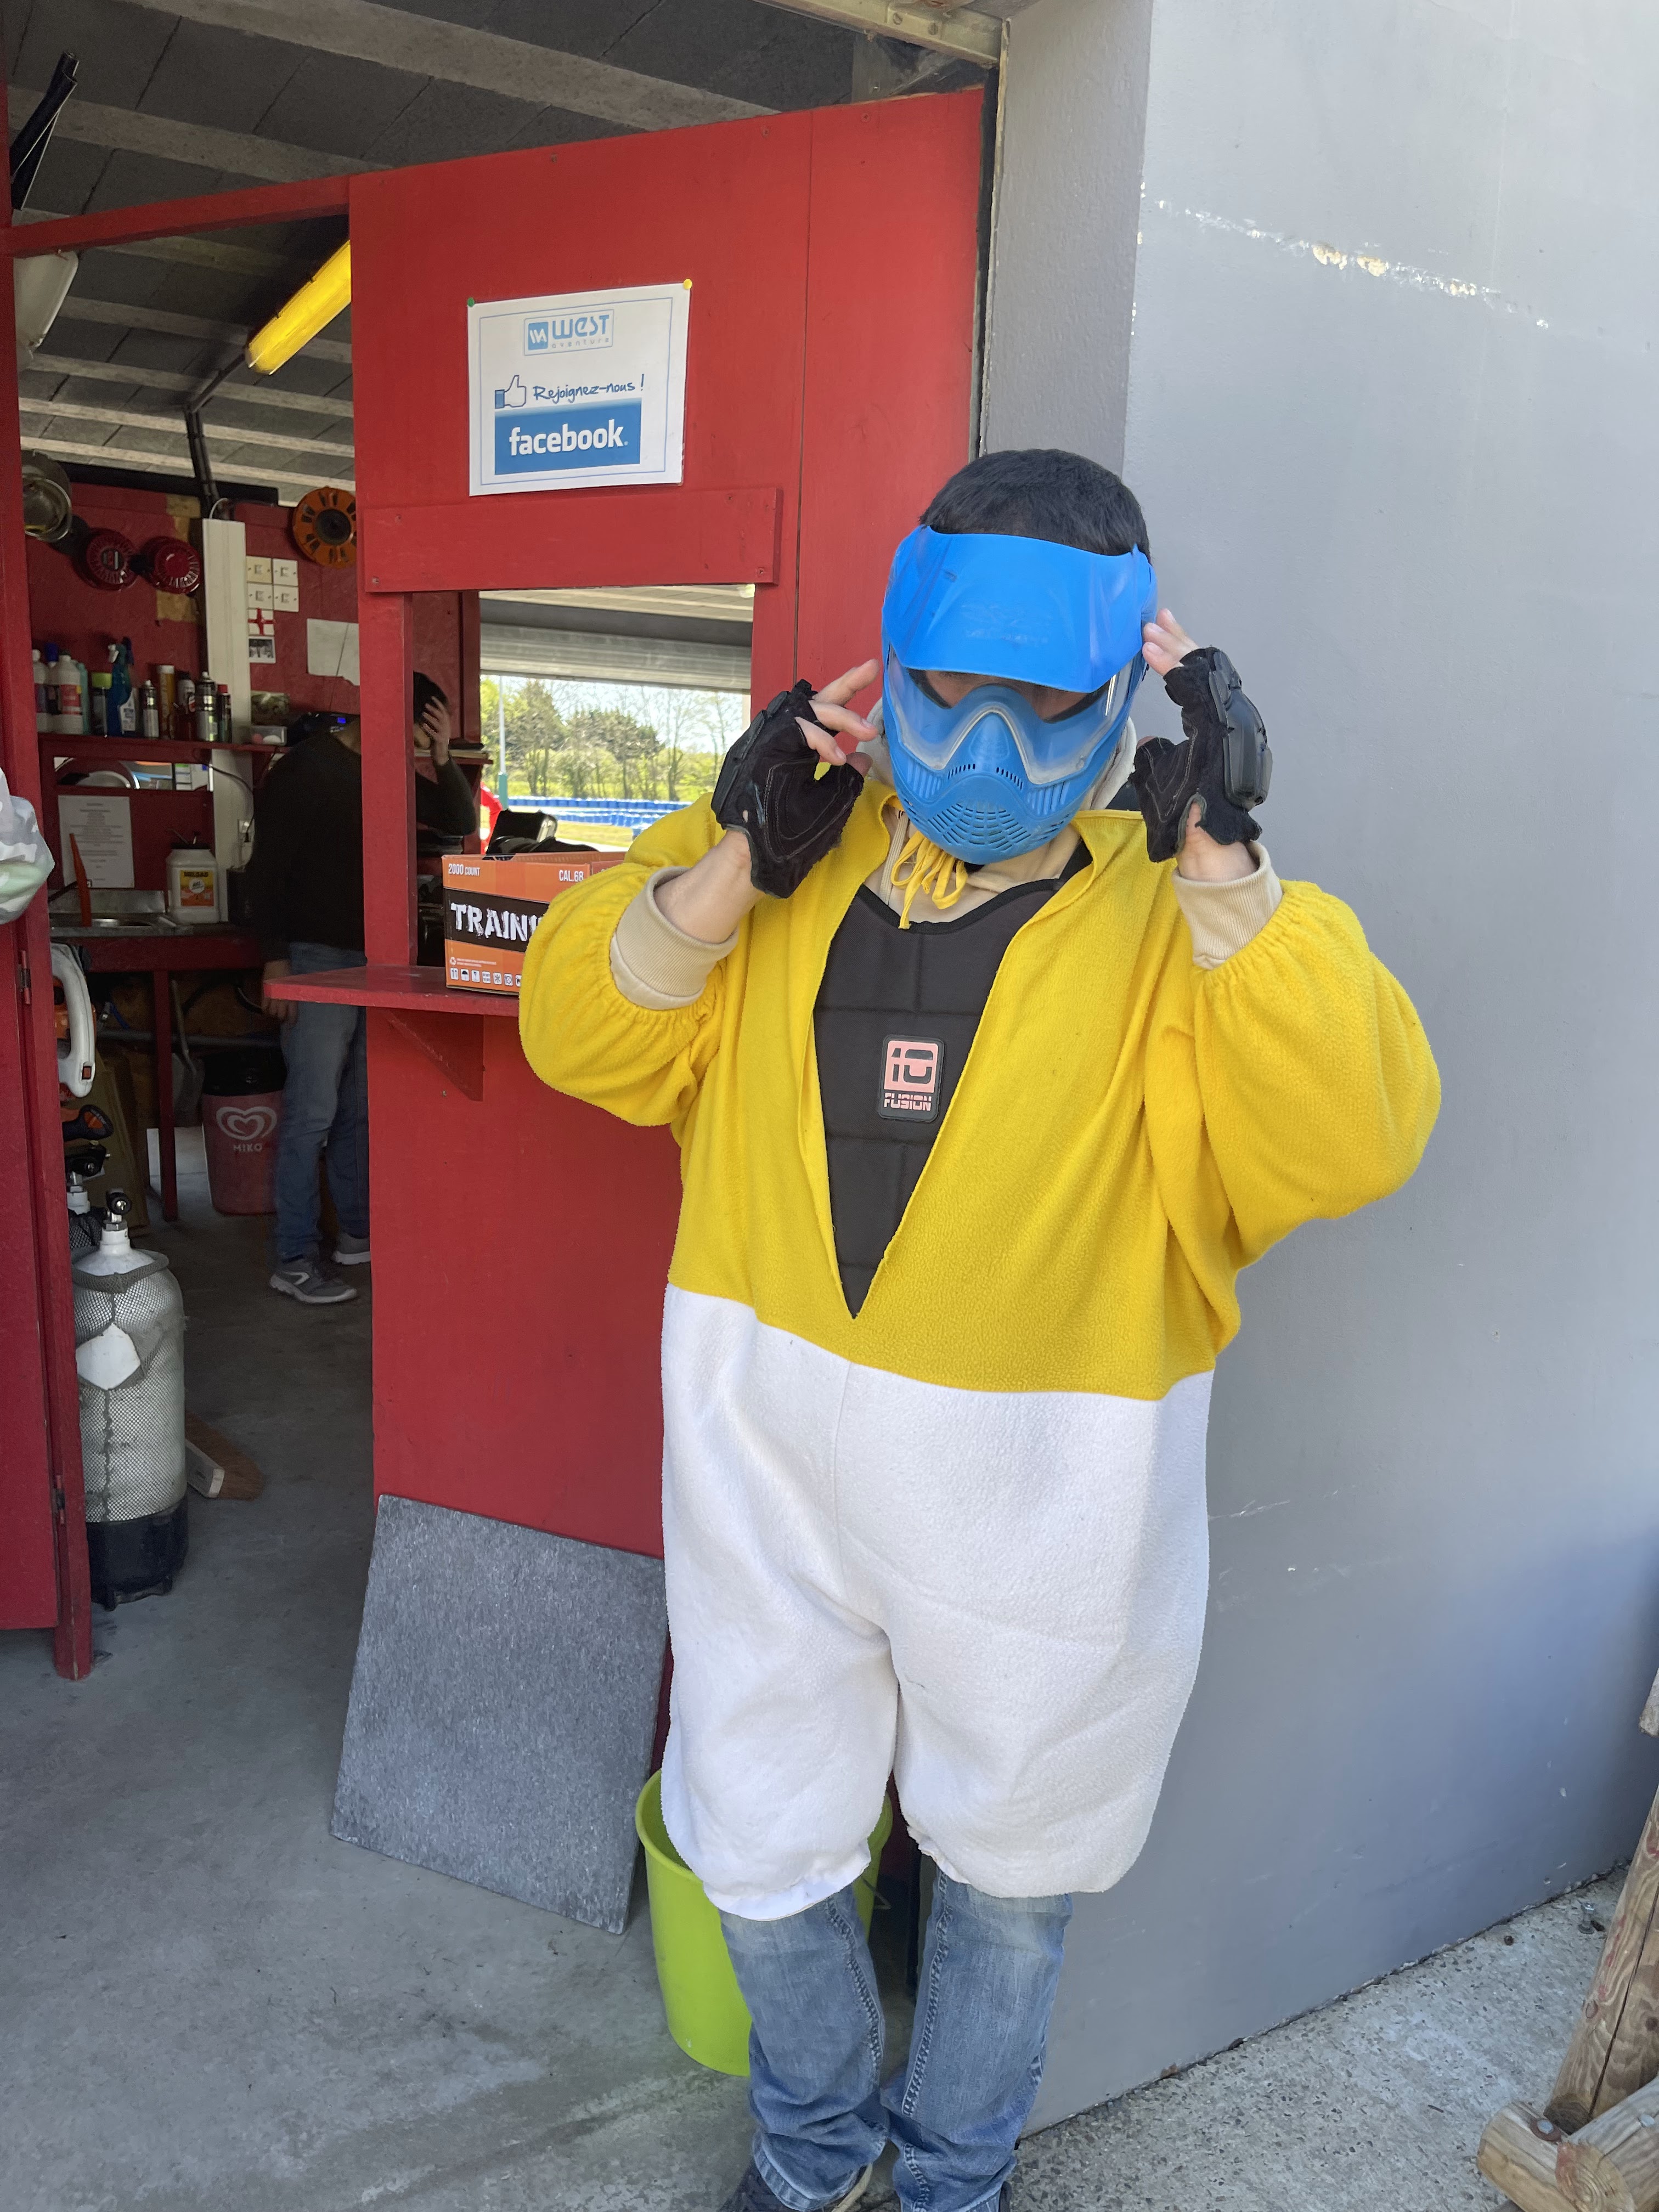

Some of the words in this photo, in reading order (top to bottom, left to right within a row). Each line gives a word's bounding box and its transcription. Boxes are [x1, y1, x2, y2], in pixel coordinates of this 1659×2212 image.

[551, 337, 610, 348] aventure
[533, 382, 636, 404] Rejoignez-nous
[448, 863, 464, 875] 2000
[465, 866, 480, 876] COUNT
[884, 1092, 932, 1111] FUSION
